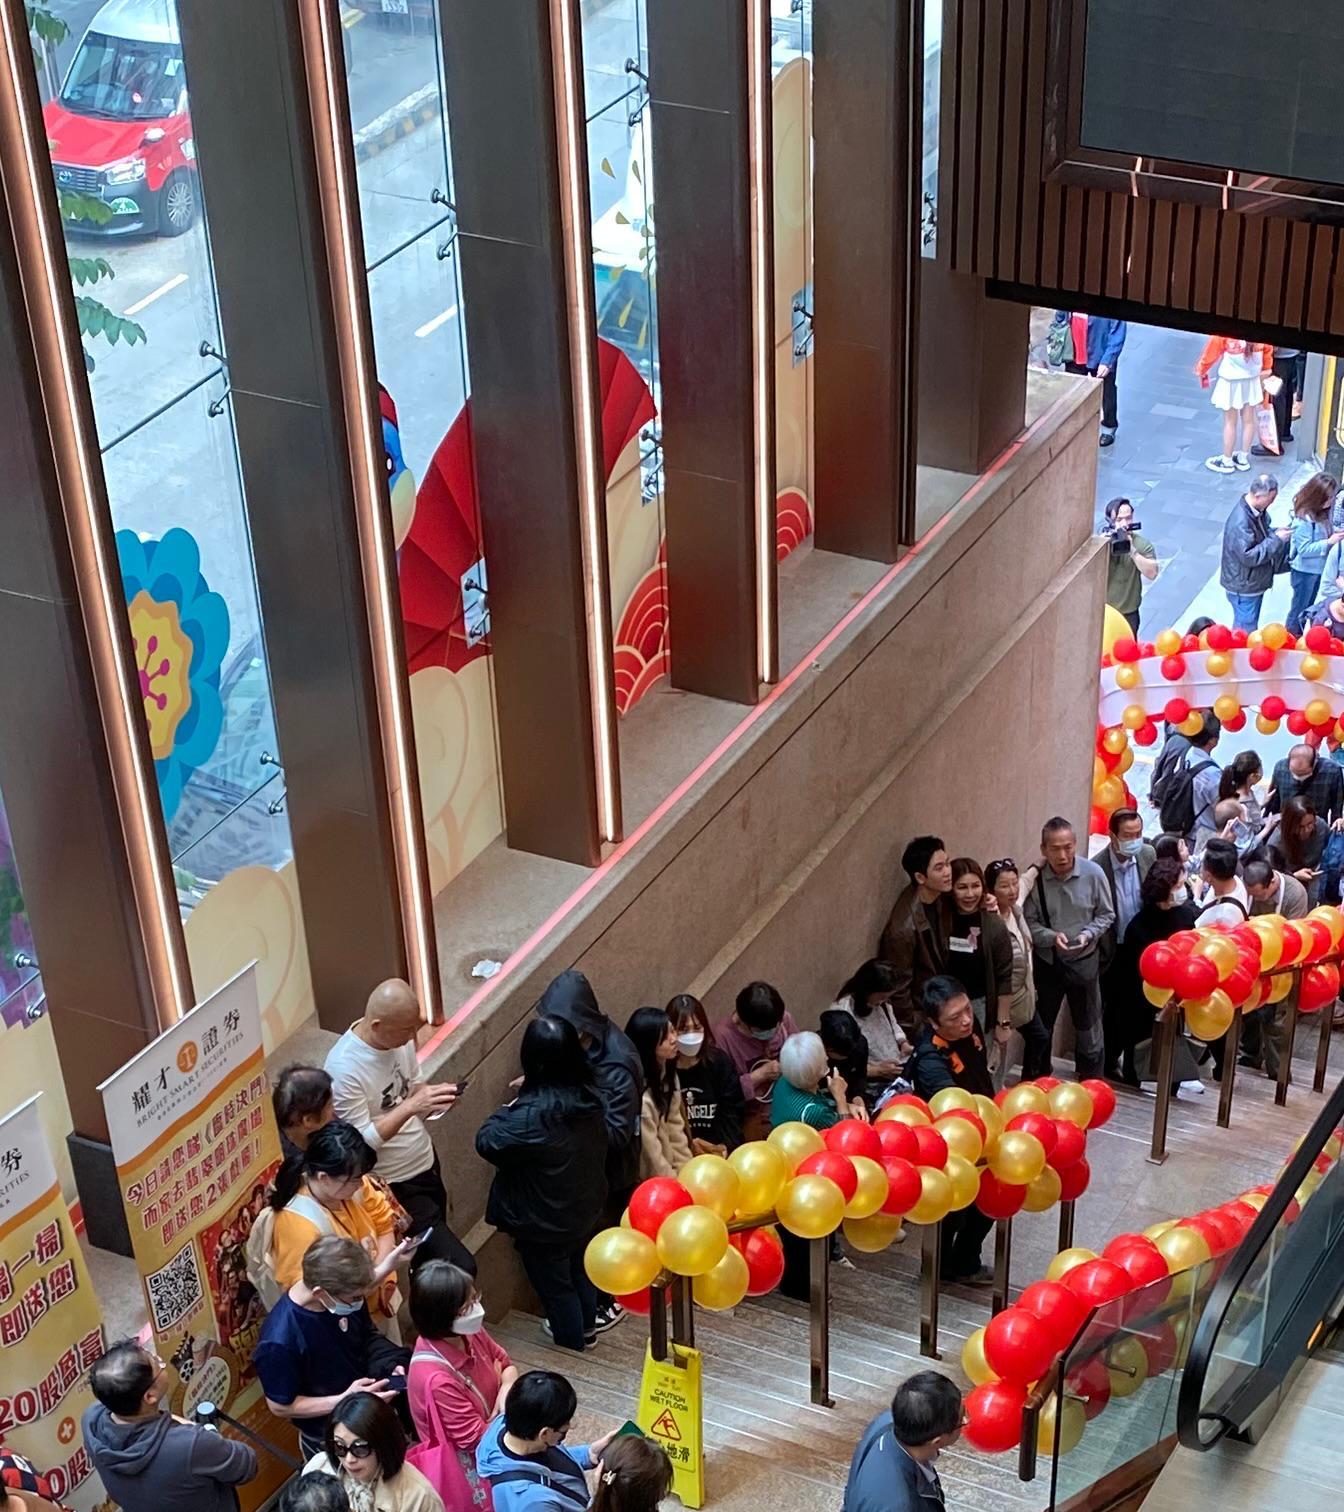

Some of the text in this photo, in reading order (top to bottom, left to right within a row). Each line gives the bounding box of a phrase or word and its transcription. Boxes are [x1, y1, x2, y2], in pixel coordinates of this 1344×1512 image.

[169, 1071, 200, 1099] SMART
[0, 1262, 75, 1346] 即送您
[649, 1394, 665, 1406] WET
[654, 1388, 686, 1404] CAUTION
